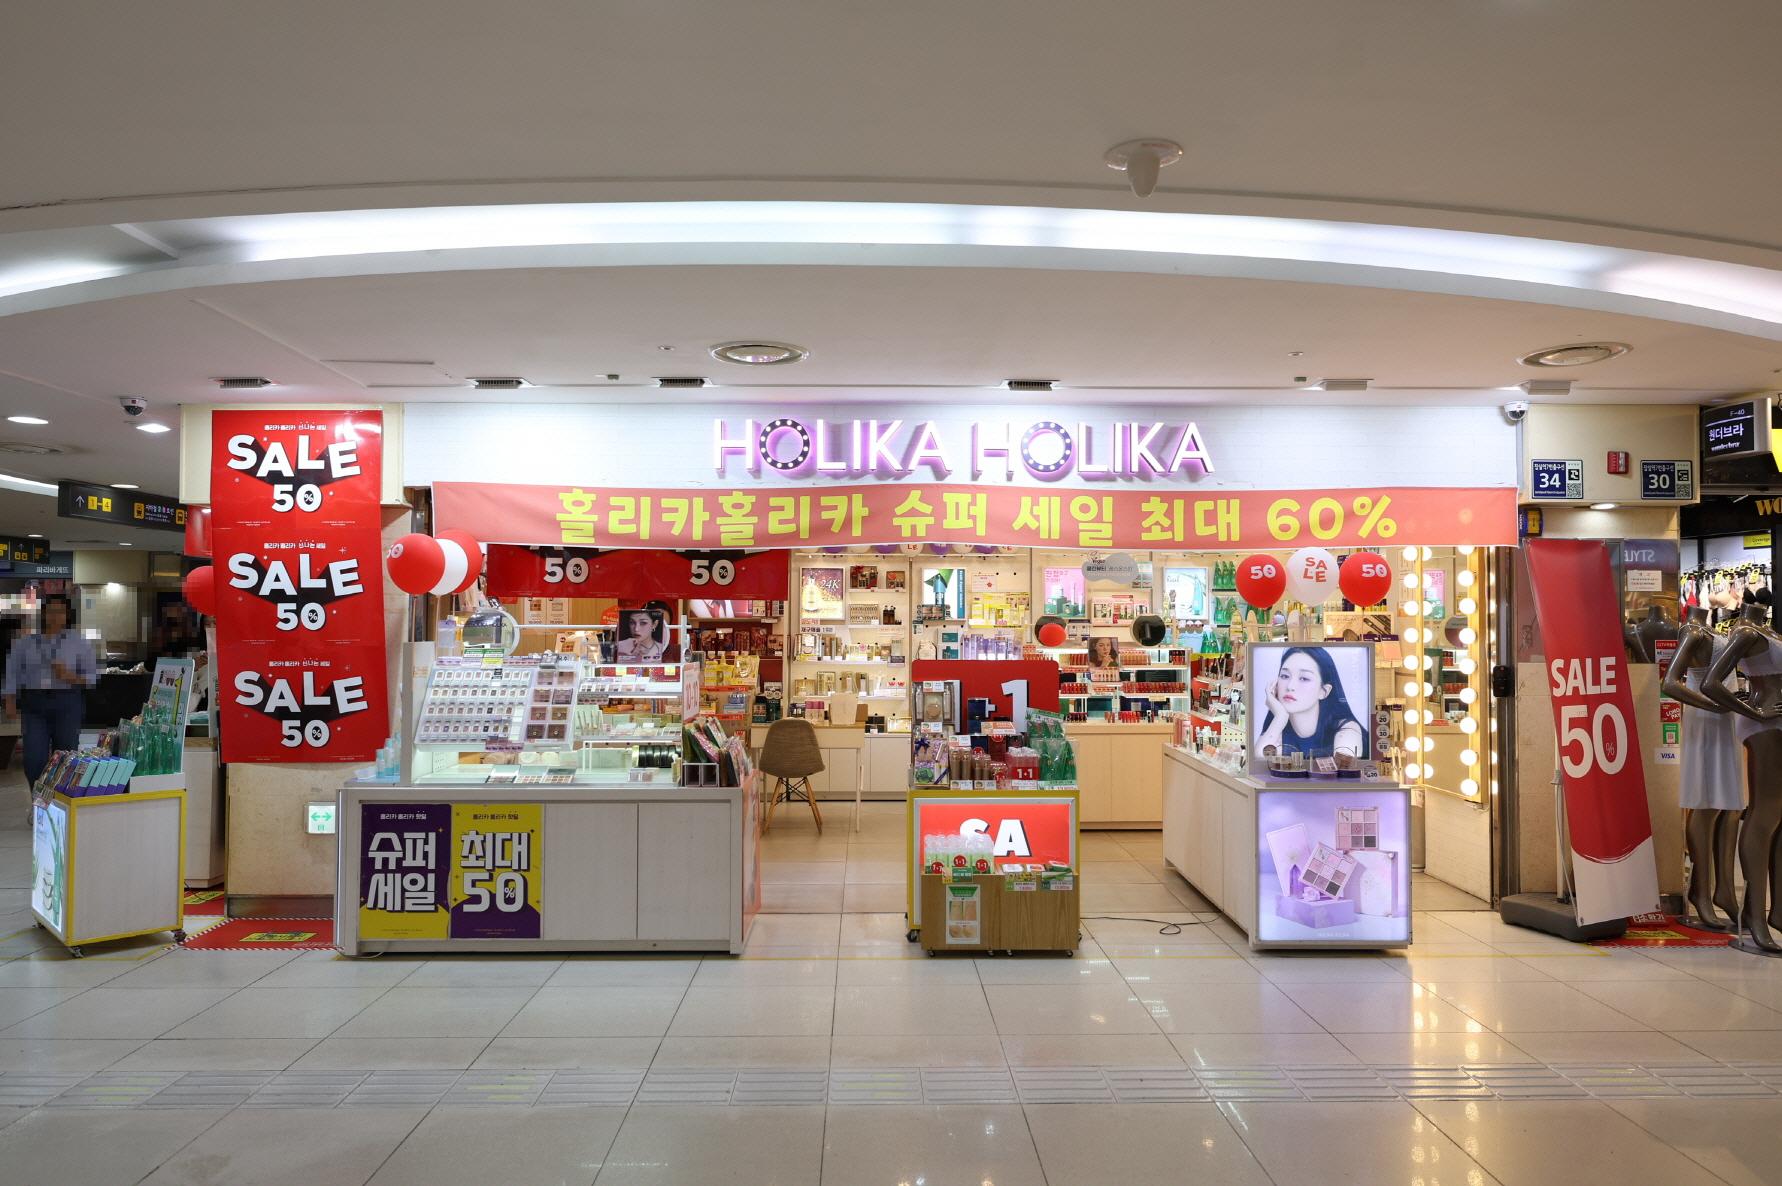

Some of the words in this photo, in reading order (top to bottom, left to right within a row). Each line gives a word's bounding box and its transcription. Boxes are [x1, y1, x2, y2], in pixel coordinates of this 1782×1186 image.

[713, 418, 952, 473] HOLIKA
[976, 421, 1215, 474] HOLIKA
[1708, 423, 1744, 442] 원더브라
[226, 434, 361, 478] SALE
[1539, 472, 1561, 488] 34
[1648, 474, 1670, 489] 30
[893, 490, 987, 537] 슈퍼
[1012, 496, 1113, 546] 세일
[1141, 497, 1240, 541] 최대
[1267, 494, 1397, 541] 60%
[228, 552, 364, 597] SALE
[234, 670, 368, 714] SALE
[1551, 657, 1617, 697] SALE
[1017, 768, 1033, 778] 1+1
[368, 832, 436, 869] 슈퍼
[460, 830, 528, 870] 최대
[367, 873, 435, 911] 세일
